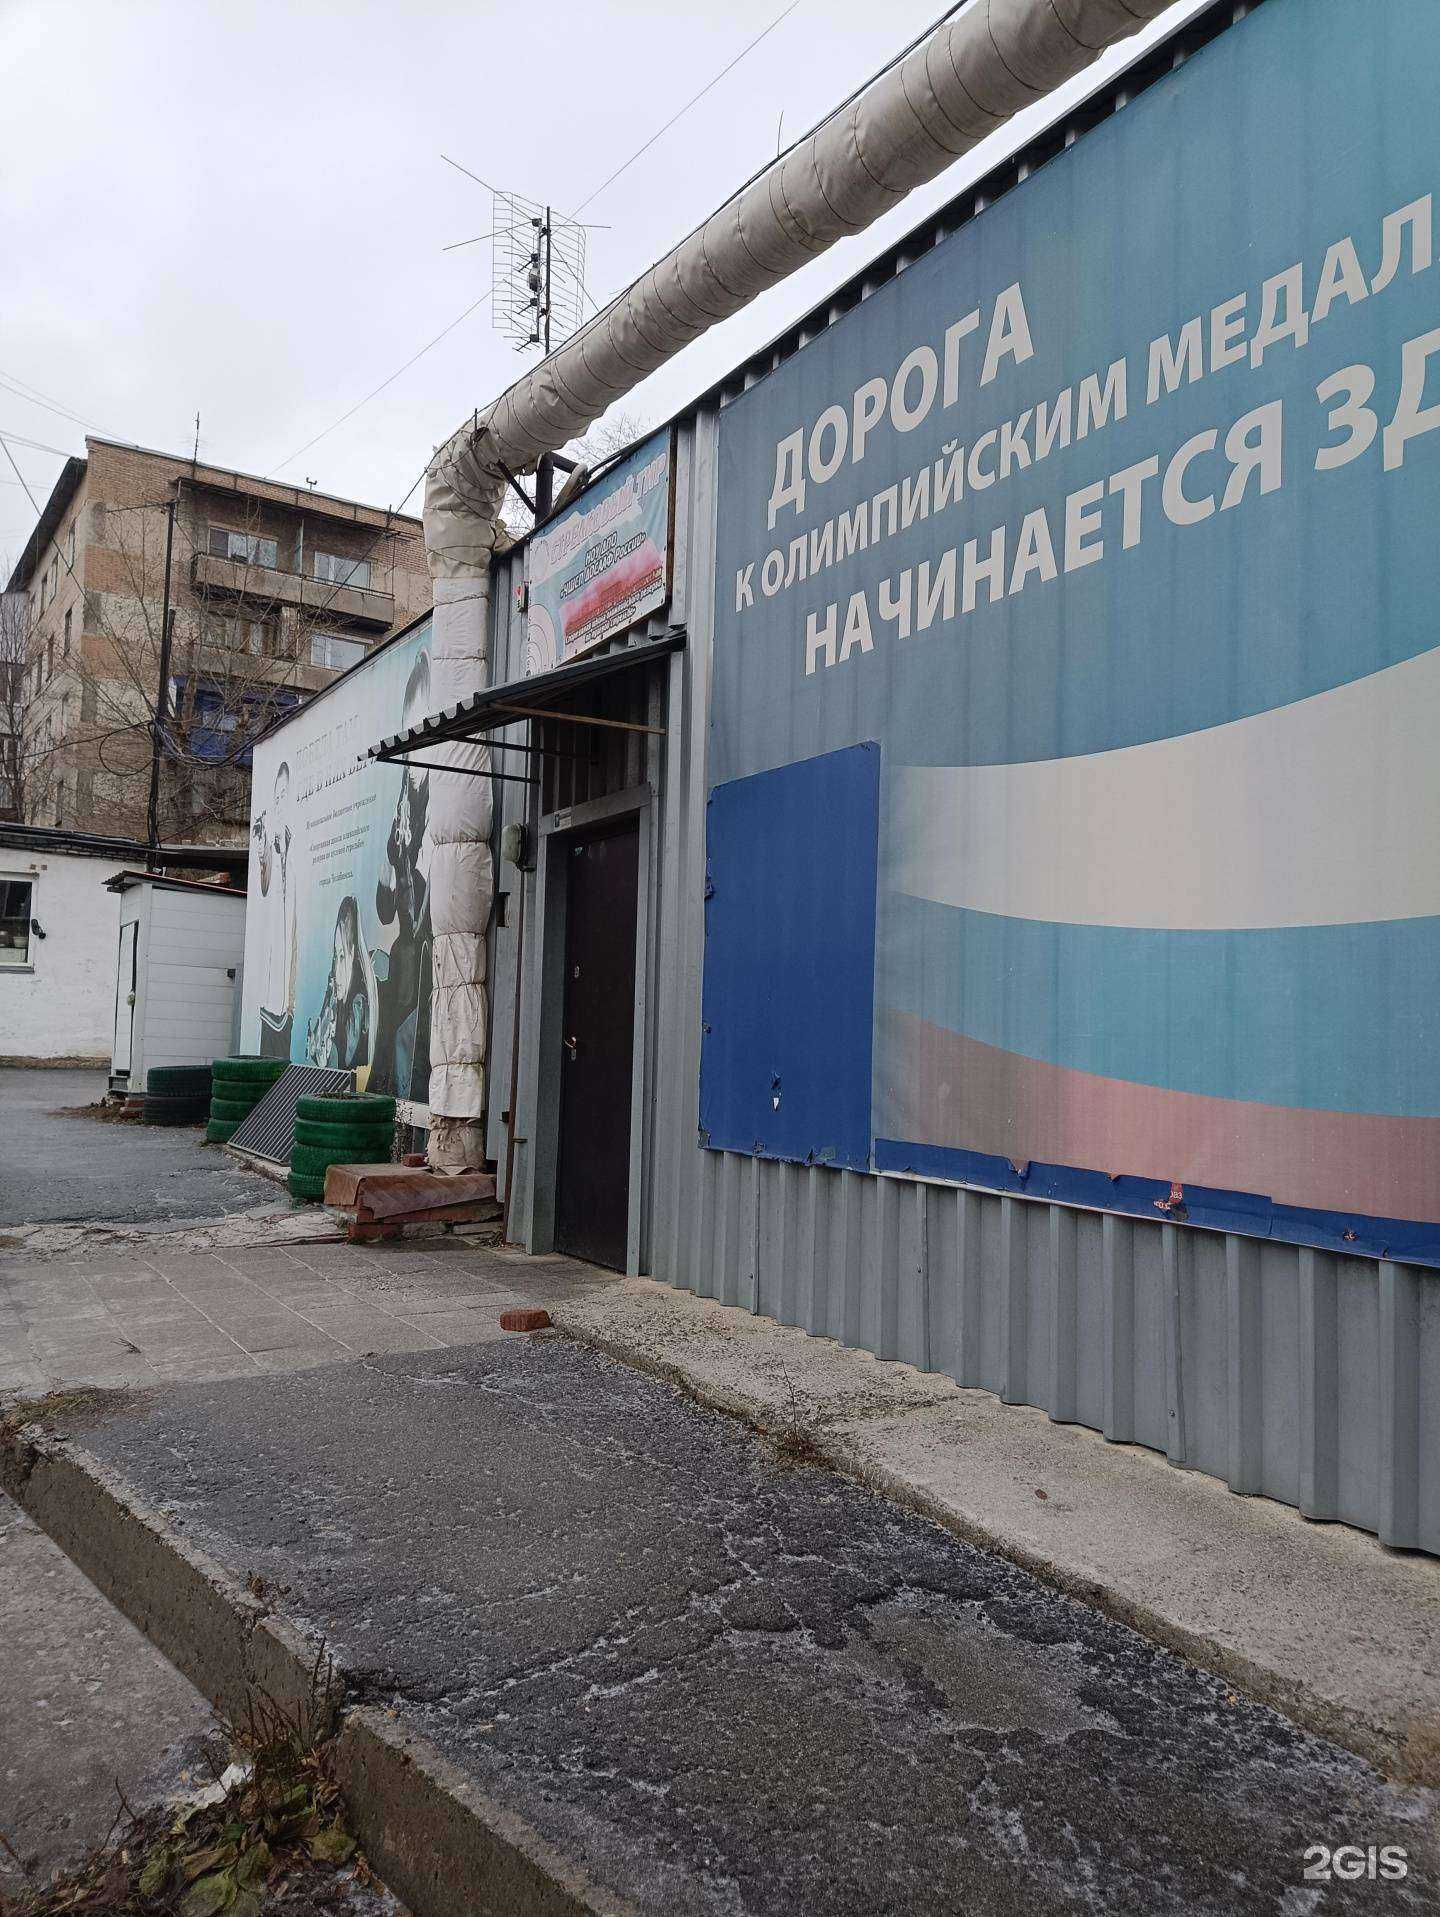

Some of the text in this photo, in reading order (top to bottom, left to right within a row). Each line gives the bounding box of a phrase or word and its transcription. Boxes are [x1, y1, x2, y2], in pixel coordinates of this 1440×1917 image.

[735, 192, 1440, 612] К ОЛИМПИЙСКИМ МЕДАЛ
[768, 282, 1035, 531] ДОРОГА
[805, 399, 1282, 676] НАЧИНАЕТСЯ
